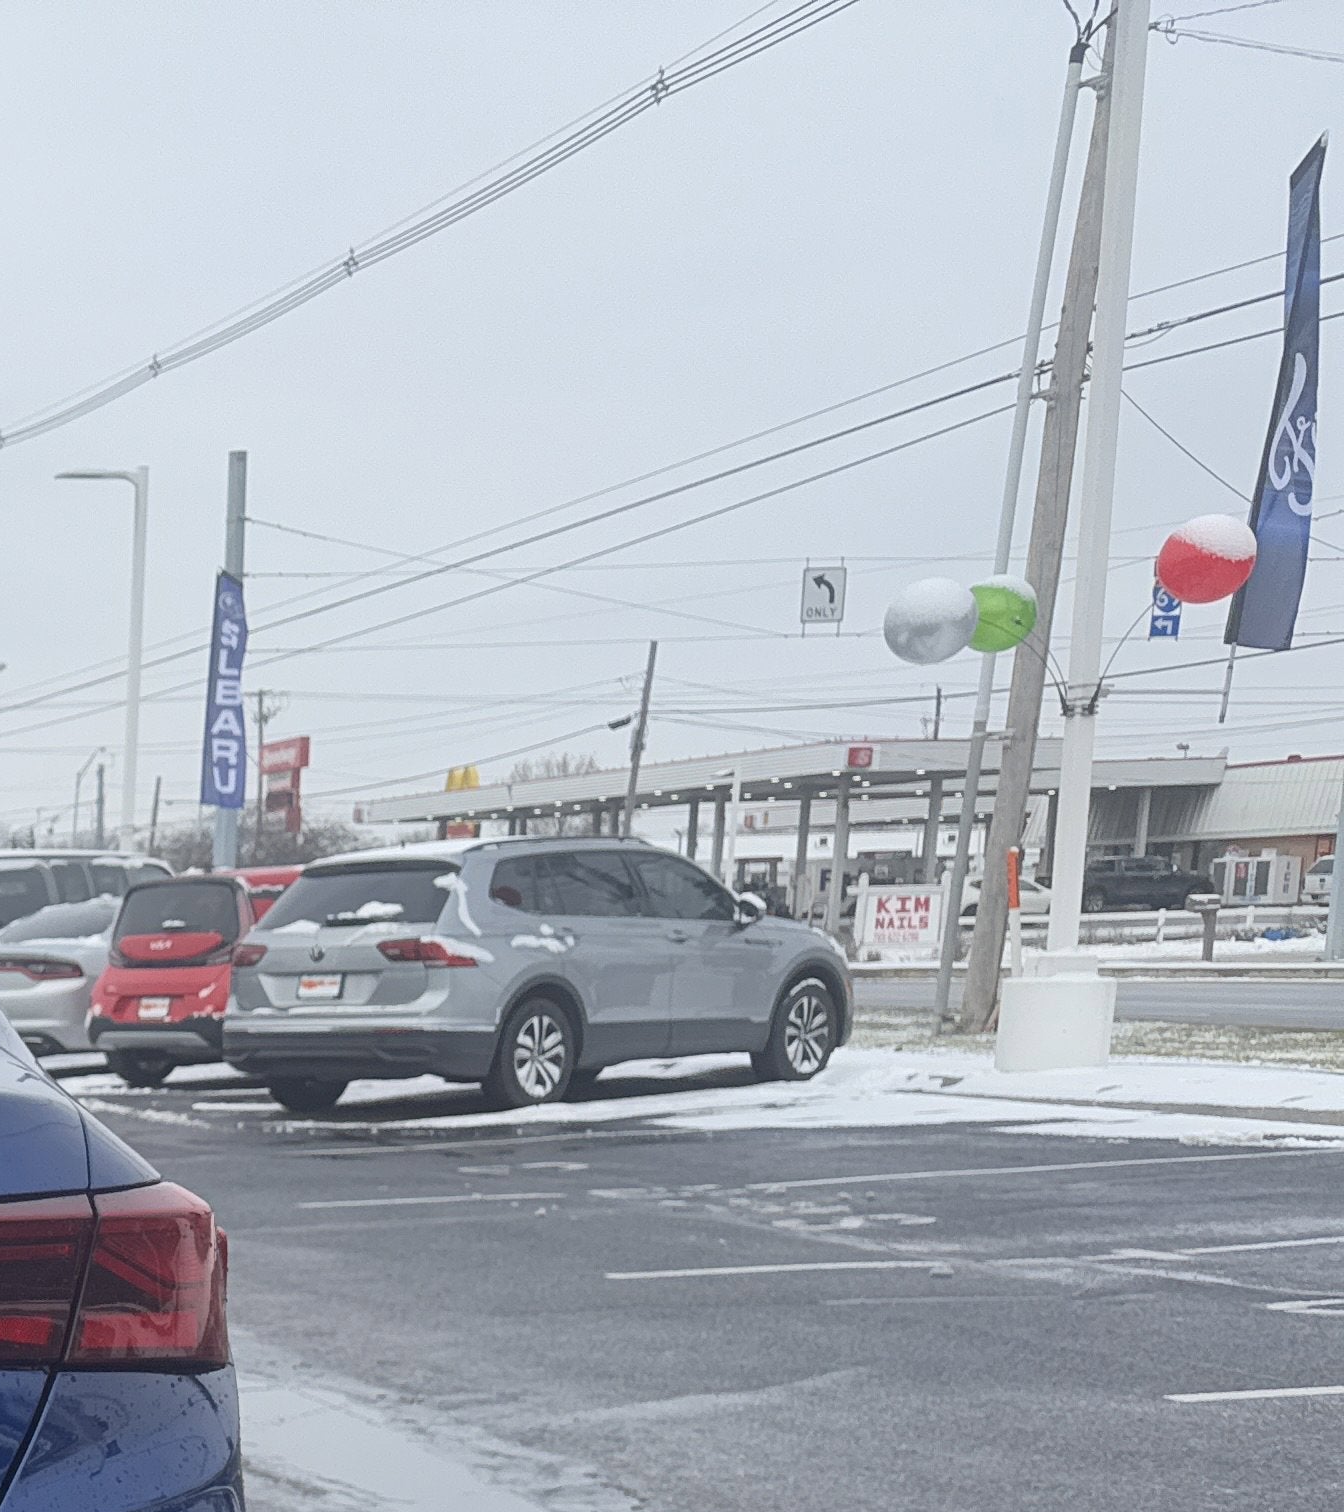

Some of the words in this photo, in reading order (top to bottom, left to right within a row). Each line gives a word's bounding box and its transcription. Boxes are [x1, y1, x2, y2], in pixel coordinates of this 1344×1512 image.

[806, 606, 838, 618] ONLY
[876, 896, 931, 914] KIM
[874, 915, 929, 930] NAILS
